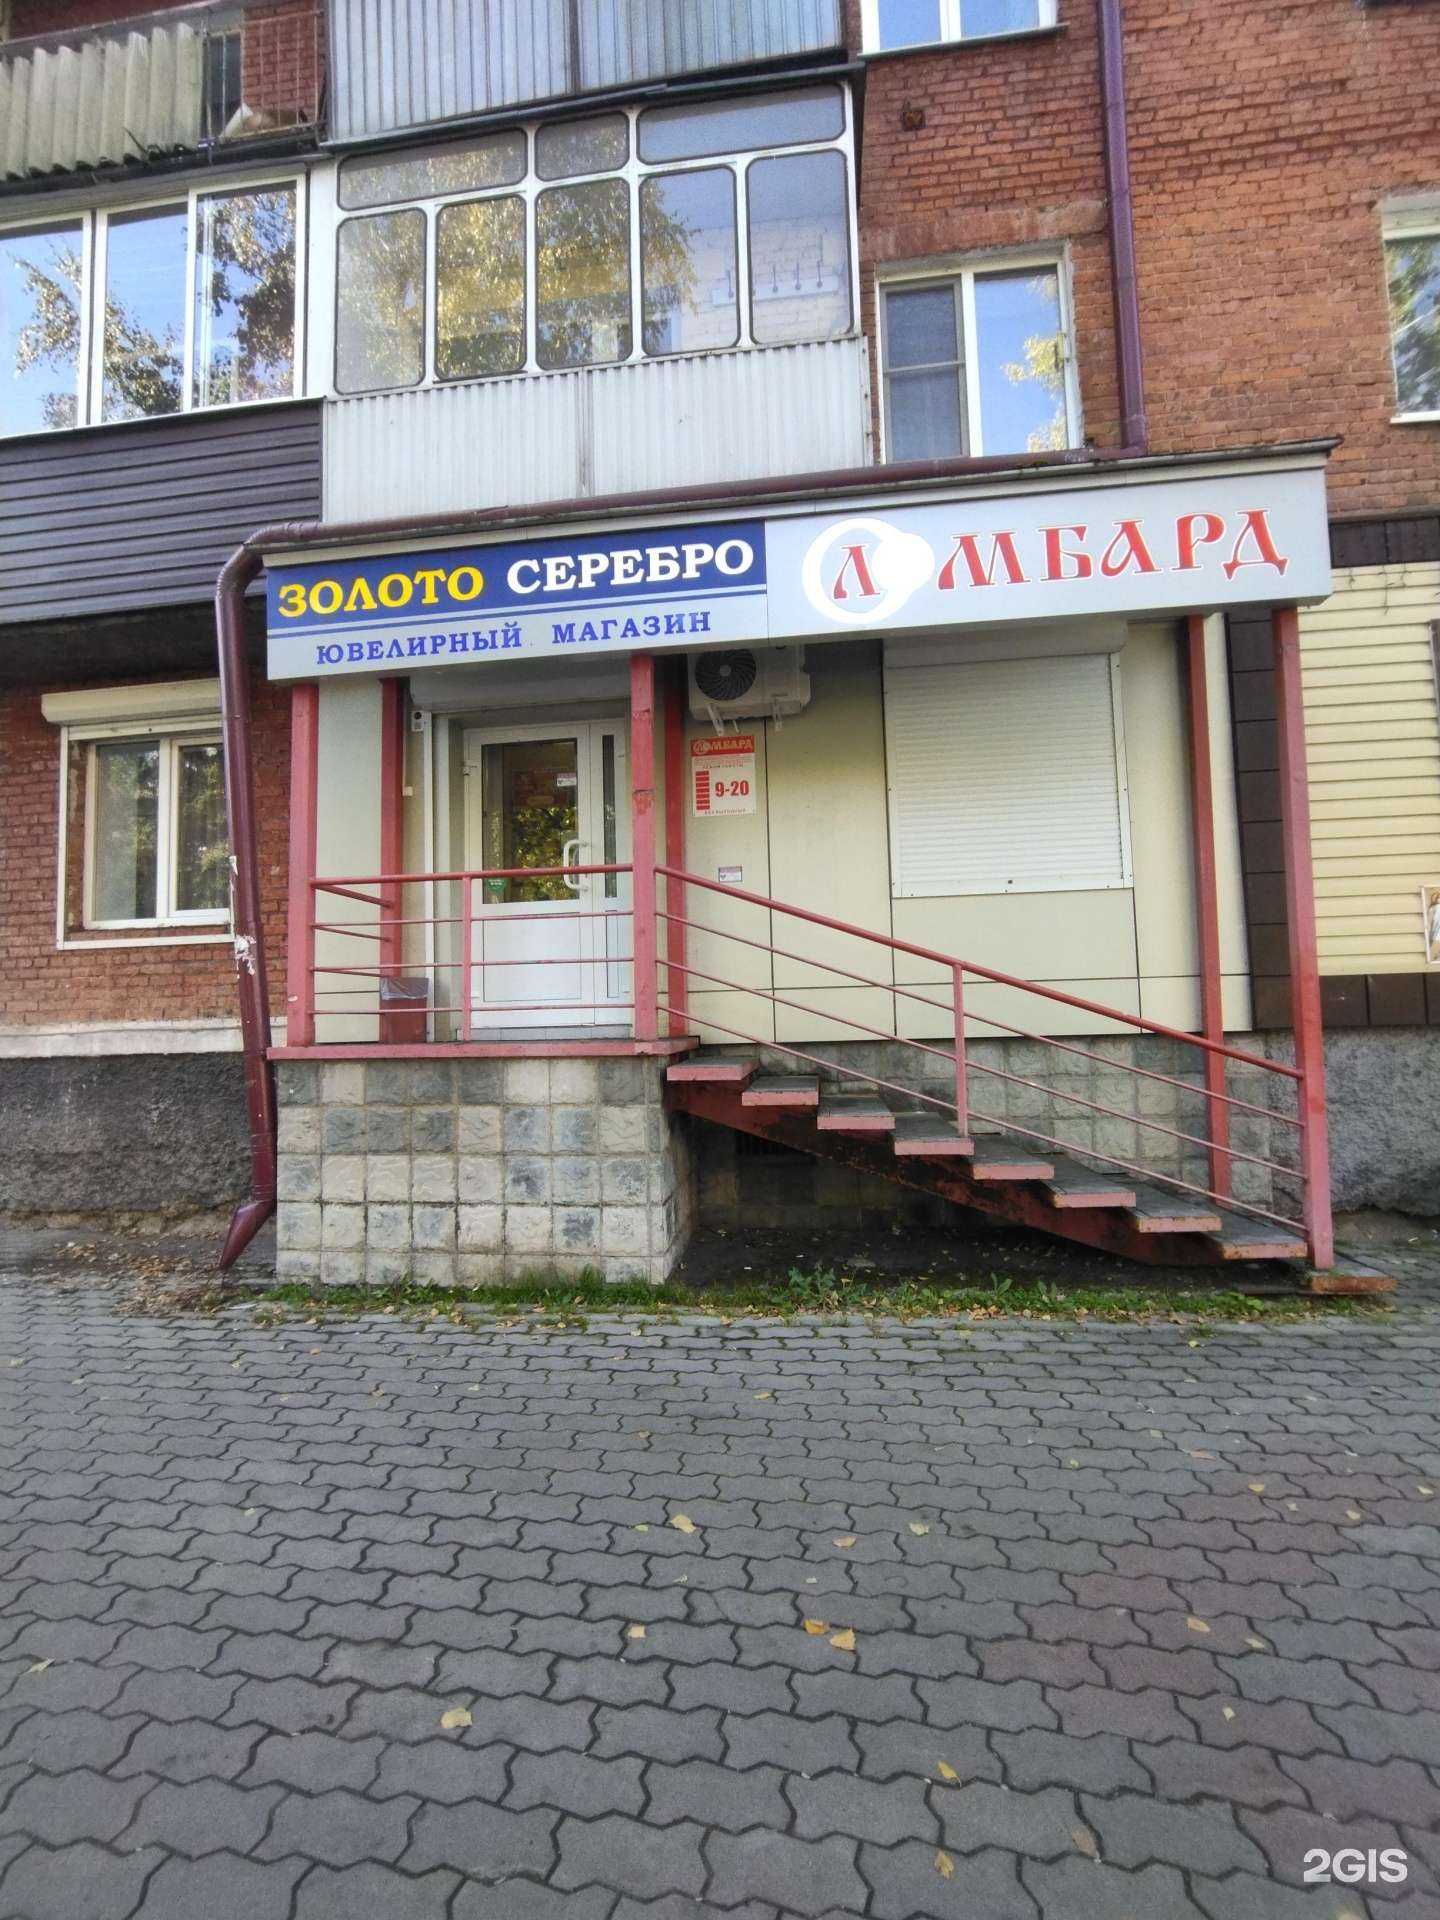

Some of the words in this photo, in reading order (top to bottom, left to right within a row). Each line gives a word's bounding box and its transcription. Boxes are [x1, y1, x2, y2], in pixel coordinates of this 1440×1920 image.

[278, 566, 485, 618] ЗОЛОТО
[506, 539, 754, 595] СЕРЕБРО
[317, 622, 522, 665] ЮВЕЛИРНЫЙ
[552, 611, 711, 645] МАГАЗИН
[714, 780, 750, 797] 9-20
